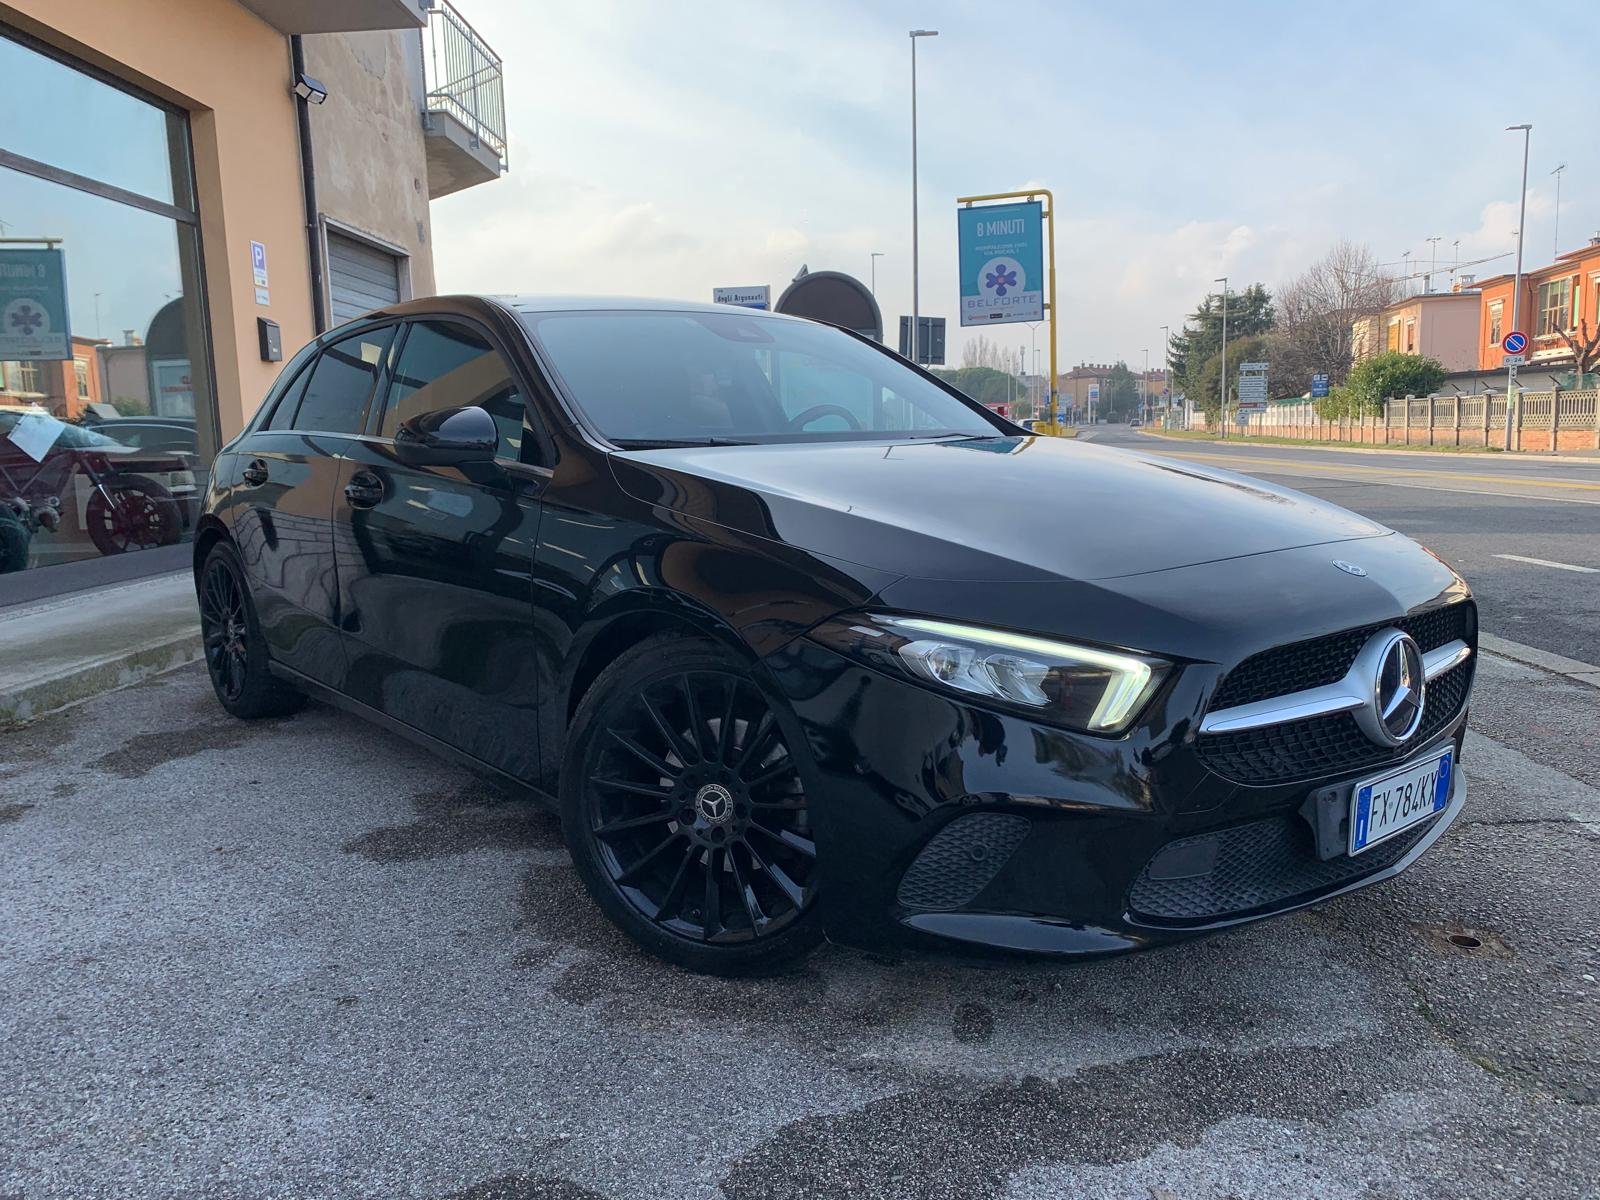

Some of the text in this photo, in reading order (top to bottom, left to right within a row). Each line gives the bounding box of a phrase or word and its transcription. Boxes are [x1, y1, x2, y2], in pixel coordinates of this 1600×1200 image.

[976, 218, 1025, 237] 8 MINUTI
[253, 246, 263, 266] P
[734, 294, 763, 303] Argonauti
[967, 295, 1037, 309] BELFORTE
[1369, 771, 1438, 832] FX 784KX
